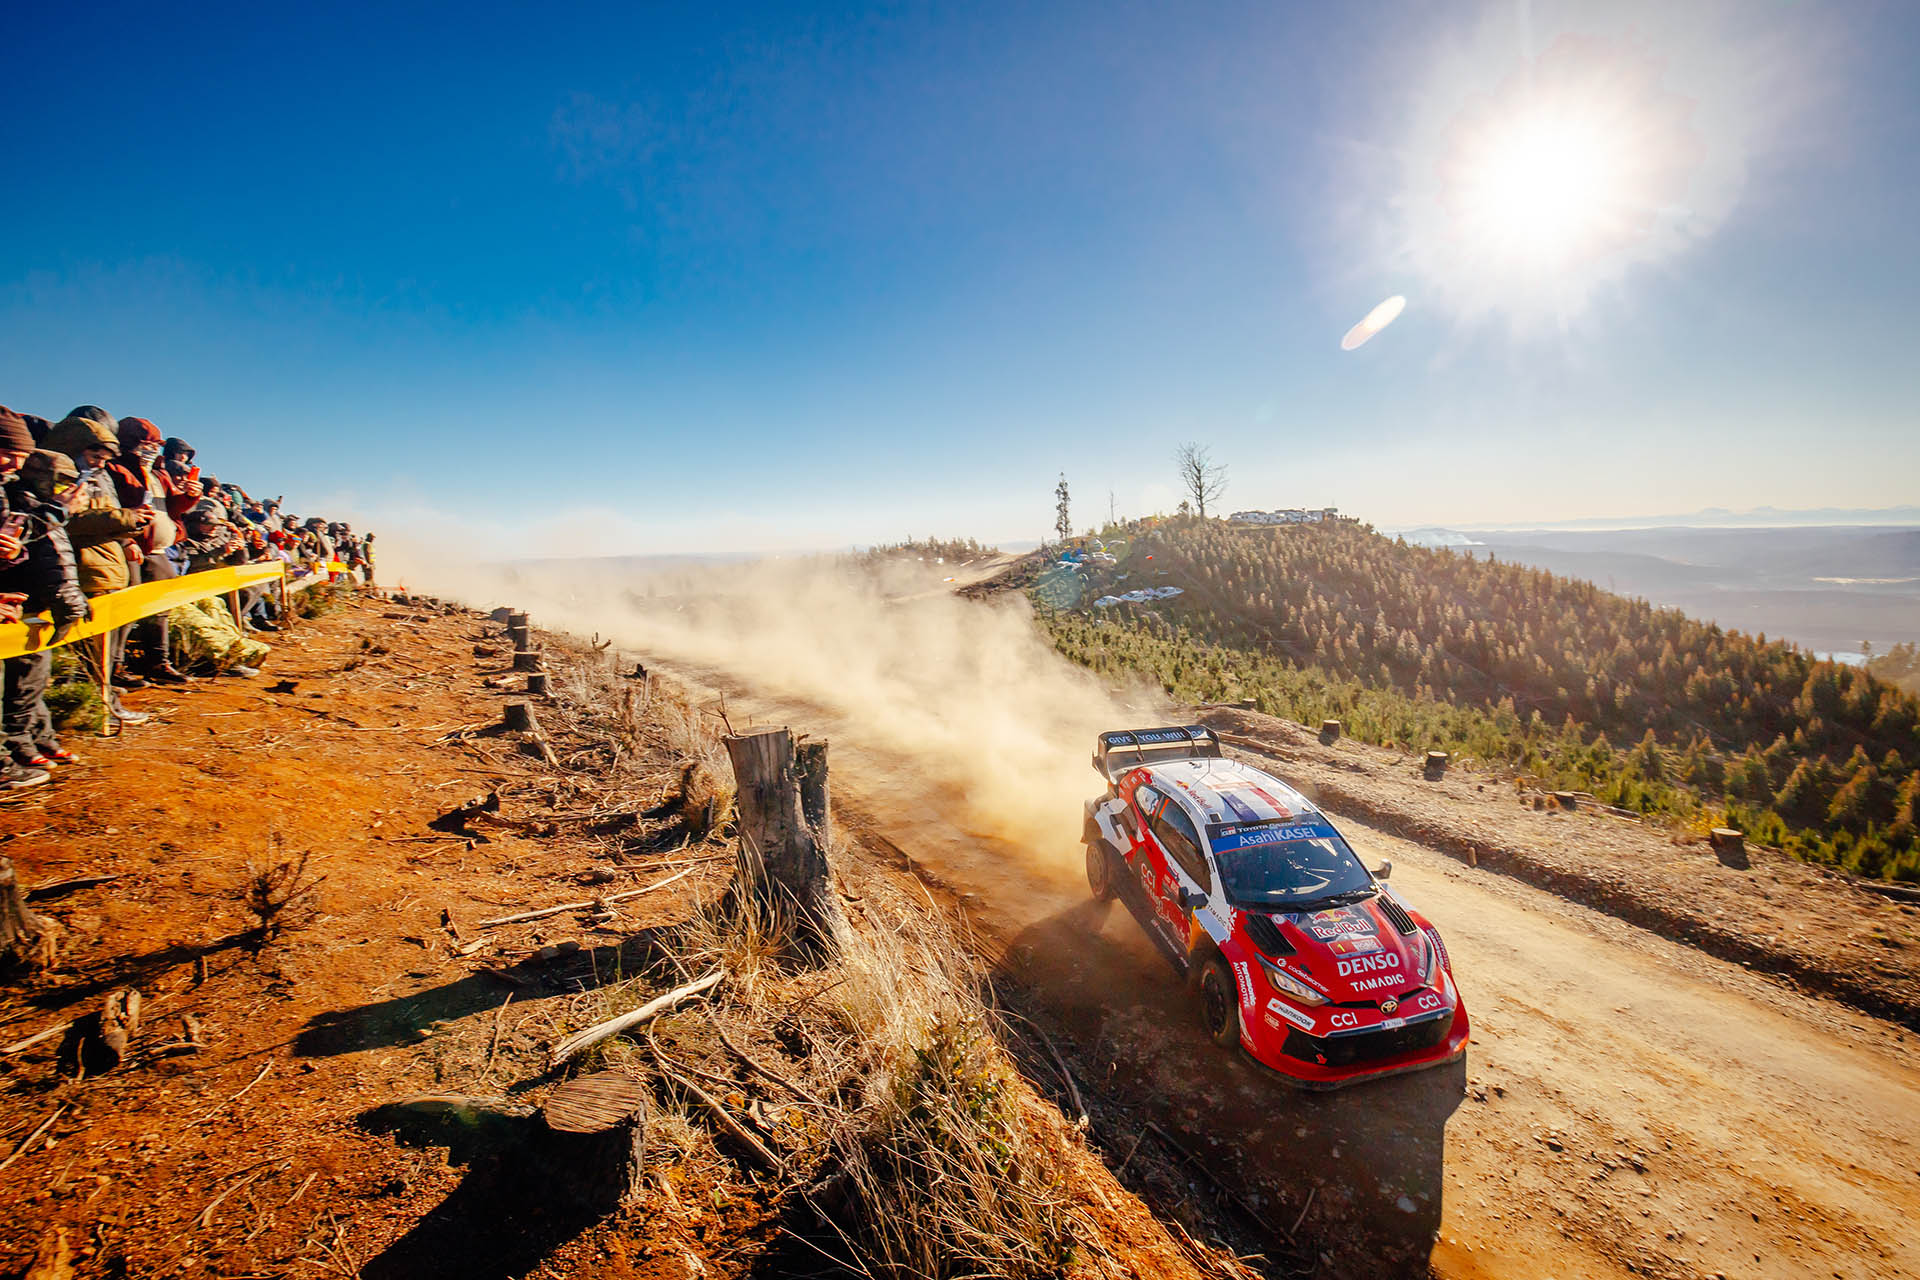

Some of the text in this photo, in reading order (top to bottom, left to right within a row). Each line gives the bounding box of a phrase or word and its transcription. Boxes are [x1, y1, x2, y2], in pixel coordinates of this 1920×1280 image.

[1138, 733, 1162, 742] YOU
[1237, 824, 1269, 833] TOYOTA
[1337, 943, 1346, 953] 1
[1336, 952, 1400, 977] DENSO
[1233, 961, 1250, 1009] AUTOMOTIVE
[1240, 961, 1257, 1007] Panasonic
[1287, 965, 1330, 993] codebeamer
[1350, 973, 1406, 993] TAMADIC
[1418, 993, 1441, 1009] CCI
[1330, 1012, 1359, 1027] CCI
